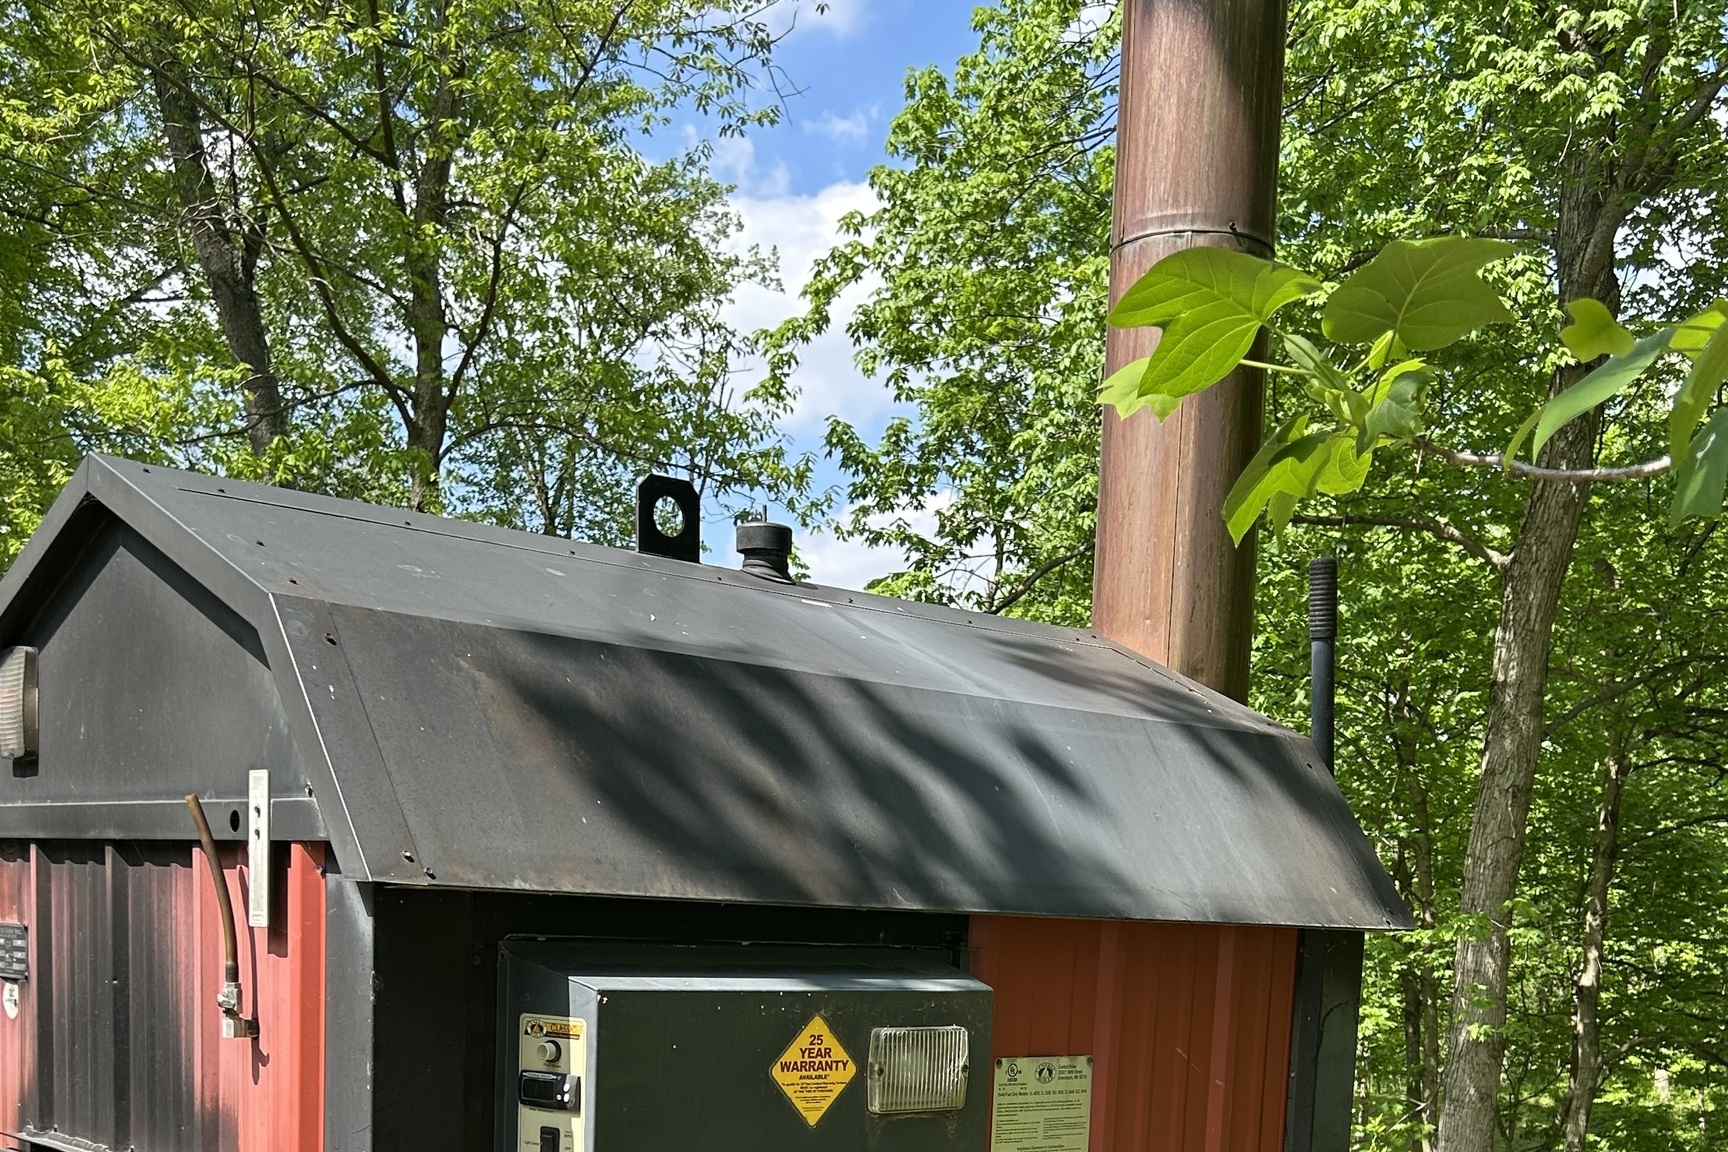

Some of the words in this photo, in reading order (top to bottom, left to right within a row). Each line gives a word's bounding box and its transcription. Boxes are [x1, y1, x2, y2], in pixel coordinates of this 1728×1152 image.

[809, 1034, 824, 1046] 25
[799, 1047, 832, 1059] YEAR
[780, 1060, 849, 1073] WARRANTY
